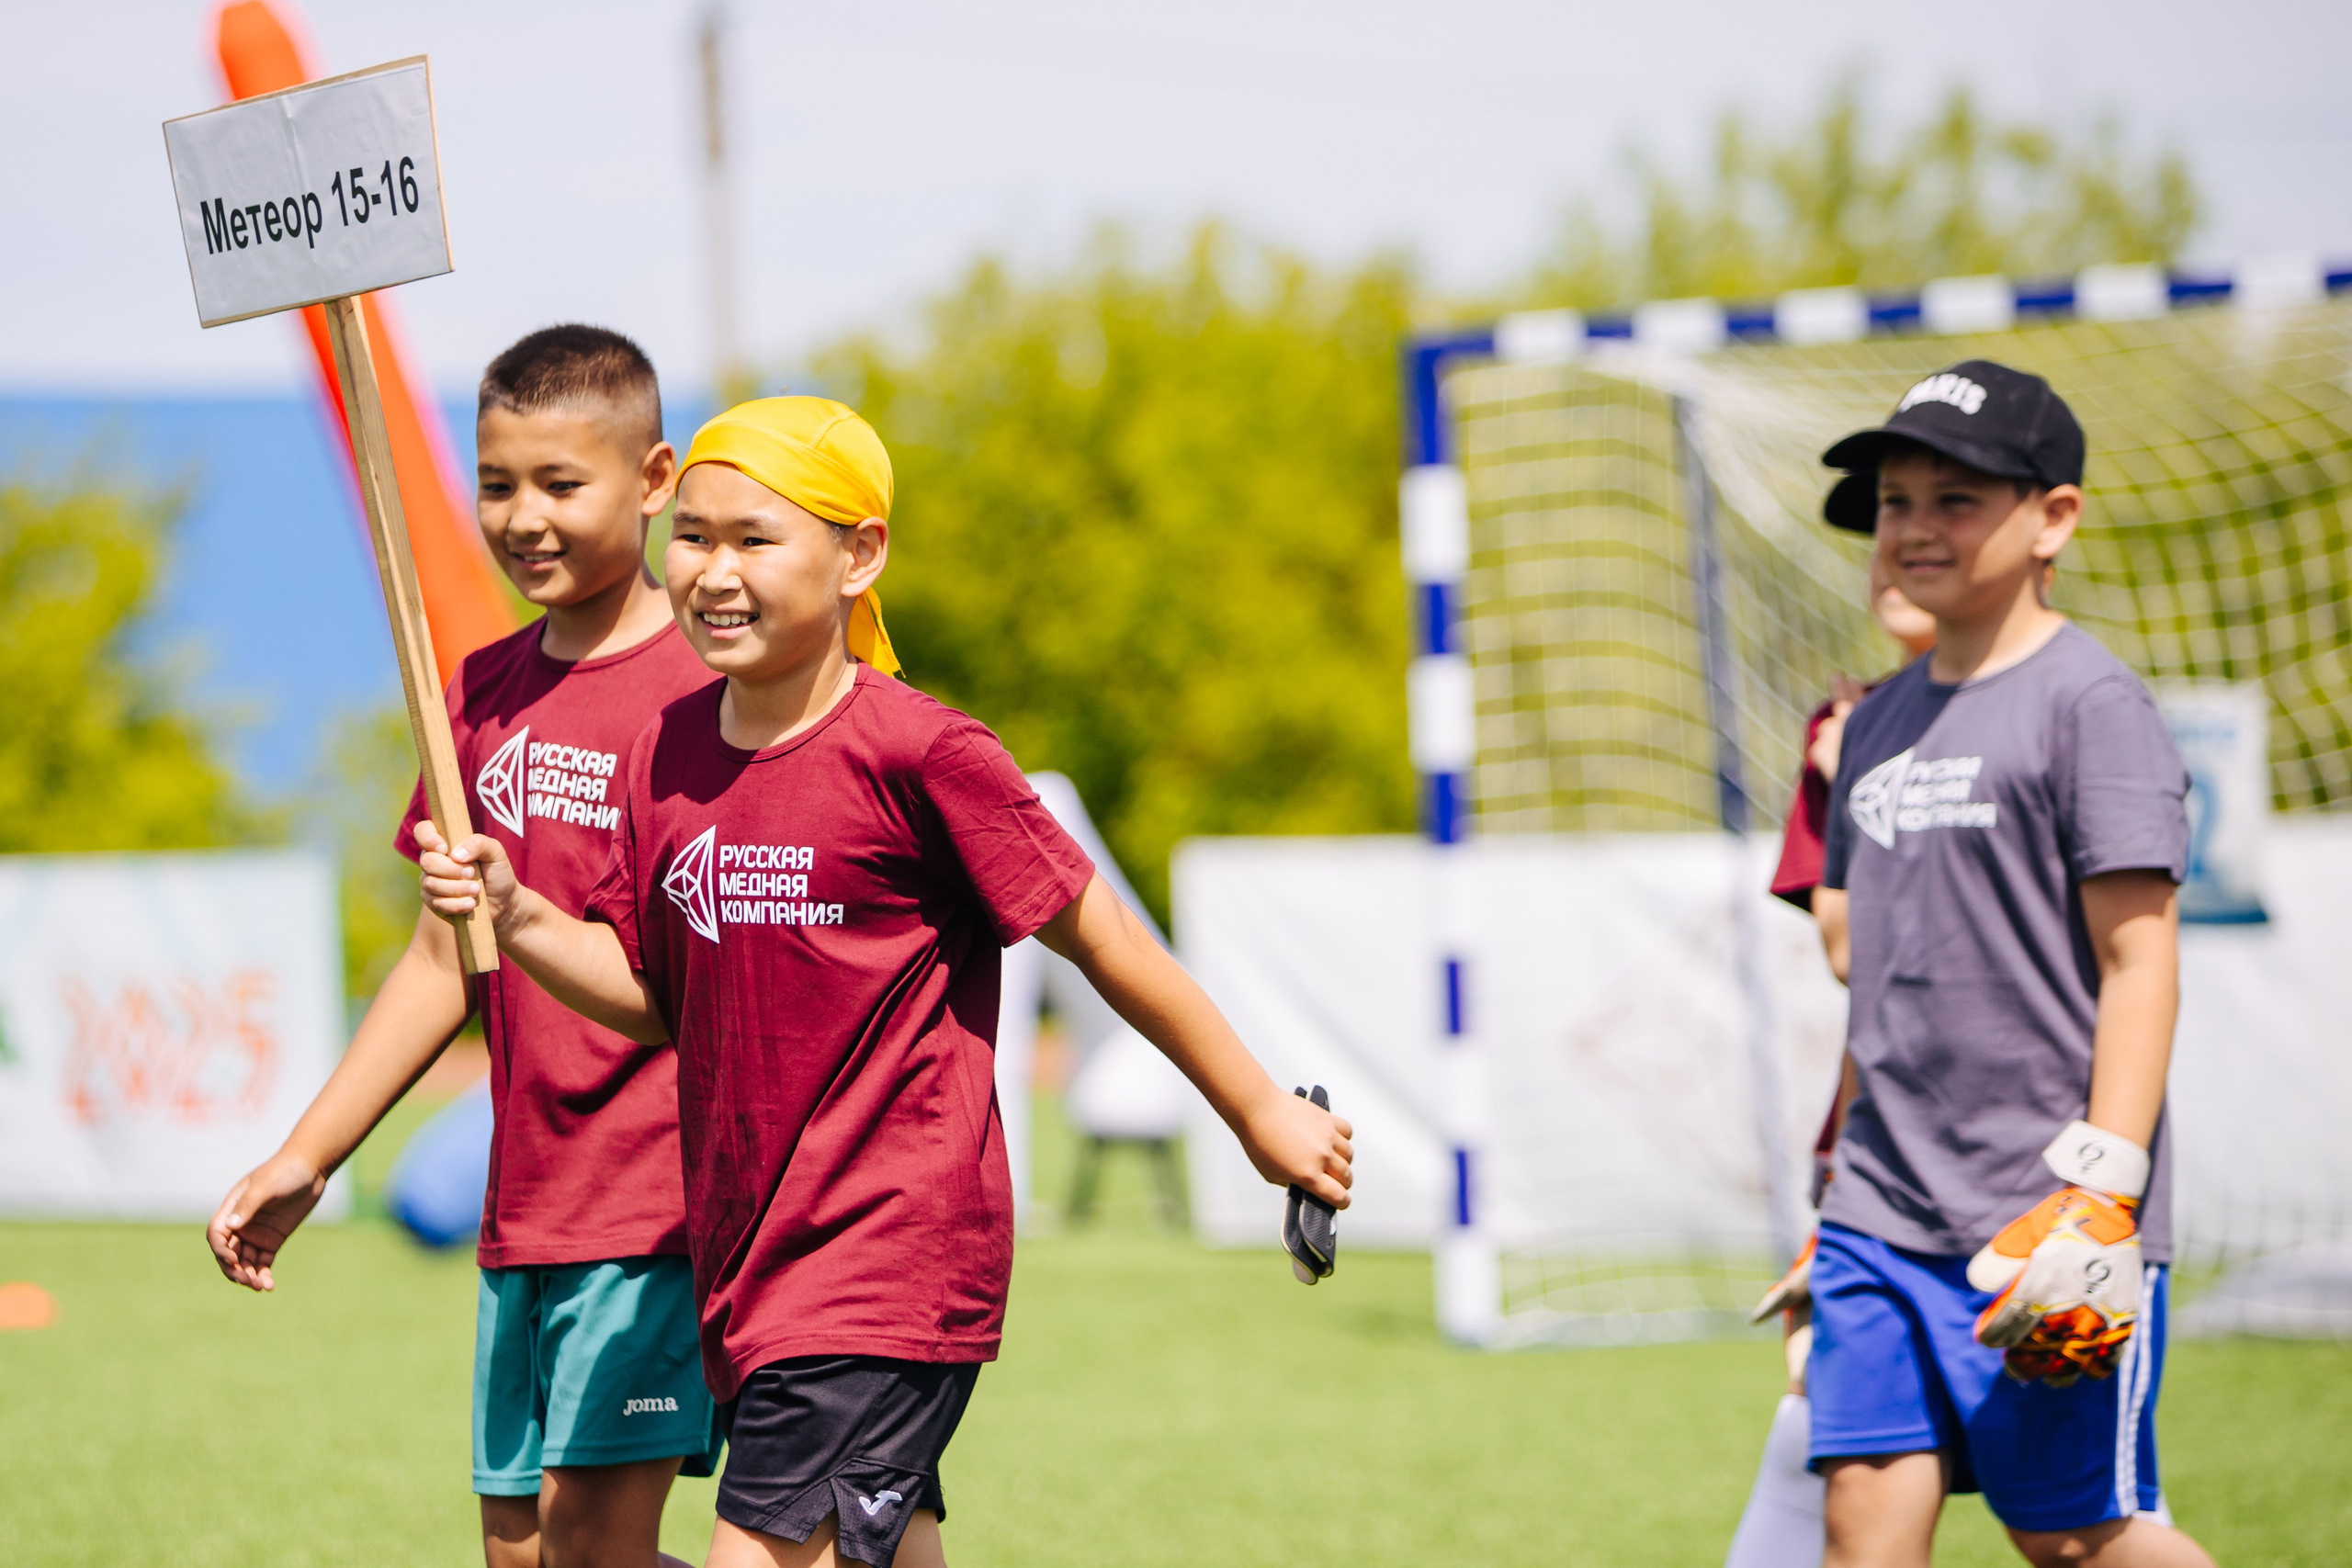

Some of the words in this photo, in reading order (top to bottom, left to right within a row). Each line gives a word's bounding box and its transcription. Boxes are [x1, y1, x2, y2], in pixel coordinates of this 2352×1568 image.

[199, 192, 322, 255] Метеор
[331, 155, 419, 227] 15-16
[528, 741, 617, 778] РУССКАЯ
[719, 844, 814, 871] РУССКАЯ
[718, 872, 808, 898] МЕДНАЯ
[719, 900, 844, 926] КОМПАНИЯ
